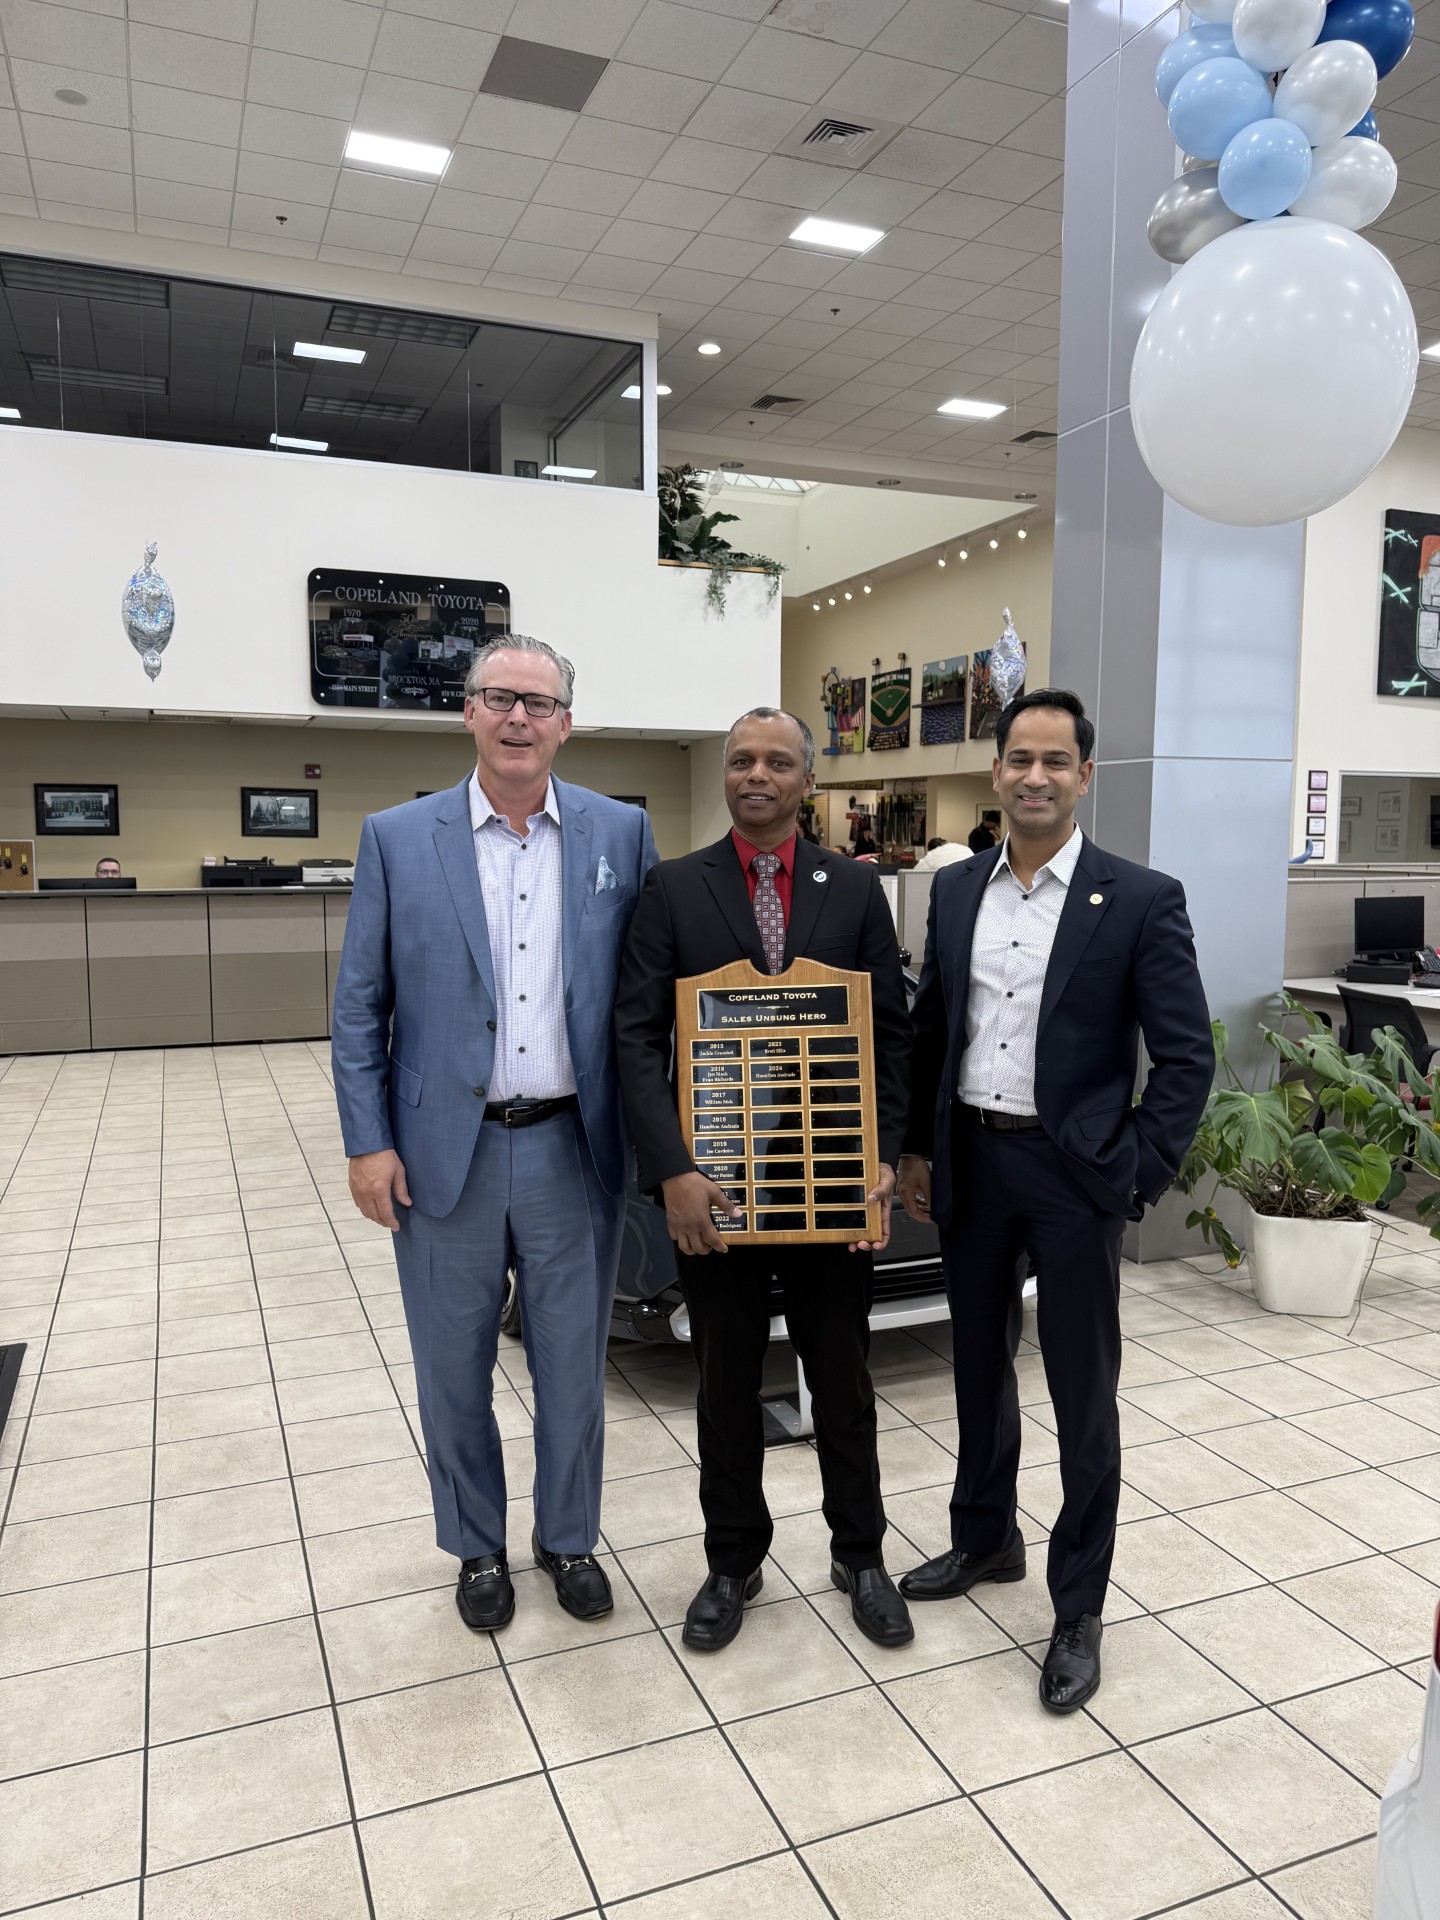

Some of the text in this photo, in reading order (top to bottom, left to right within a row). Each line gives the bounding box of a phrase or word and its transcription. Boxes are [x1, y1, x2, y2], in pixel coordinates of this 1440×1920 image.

[334, 586, 486, 611] COPELAND TOYOTA
[343, 608, 362, 618] 1970
[400, 612, 415, 624] 50
[460, 616, 479, 626] 2020
[428, 676, 440, 686] MA
[343, 684, 358, 692] MAIN
[358, 685, 378, 693] STREET
